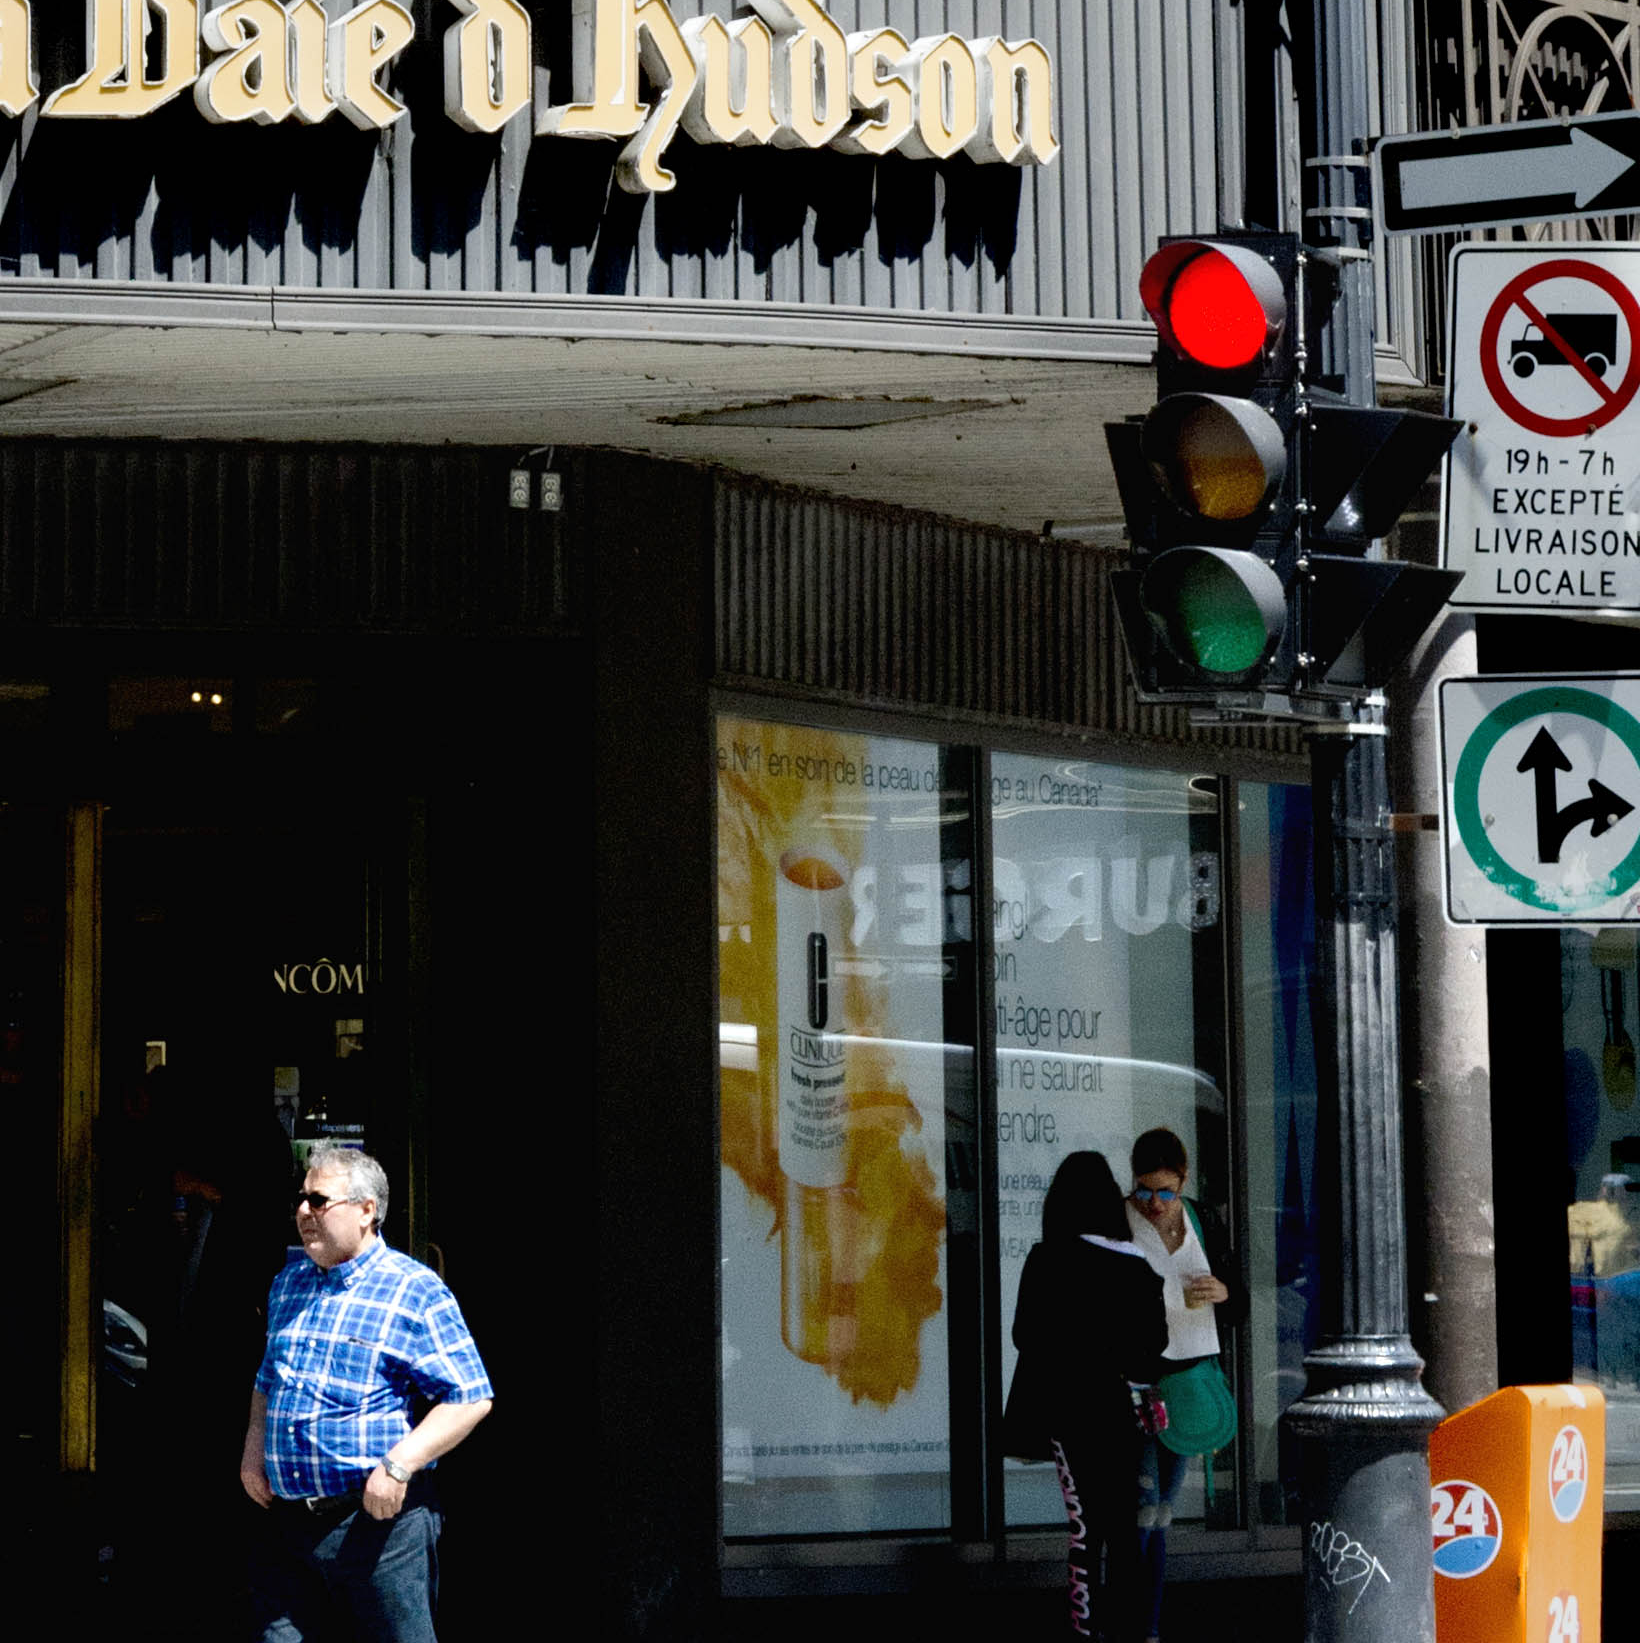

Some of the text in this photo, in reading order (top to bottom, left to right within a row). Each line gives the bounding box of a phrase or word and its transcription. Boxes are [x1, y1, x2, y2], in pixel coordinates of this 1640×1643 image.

[1493, 483, 1624, 515] EXCEPTÉ
[1496, 568, 1616, 597] LOCALE
[768, 752, 790, 777] en
[795, 754, 829, 781] soin
[834, 756, 856, 786] de
[861, 756, 873, 787] la
[878, 765, 919, 795] peau
[1015, 778, 1034, 803] au
[273, 957, 365, 995] NCÔM
[1058, 1008, 1102, 1045] pour
[1010, 1058, 1035, 1091] ne
[1041, 1054, 1103, 1094] saurait
[1553, 1434, 1583, 1482] 24
[1431, 1488, 1488, 1537] 24
